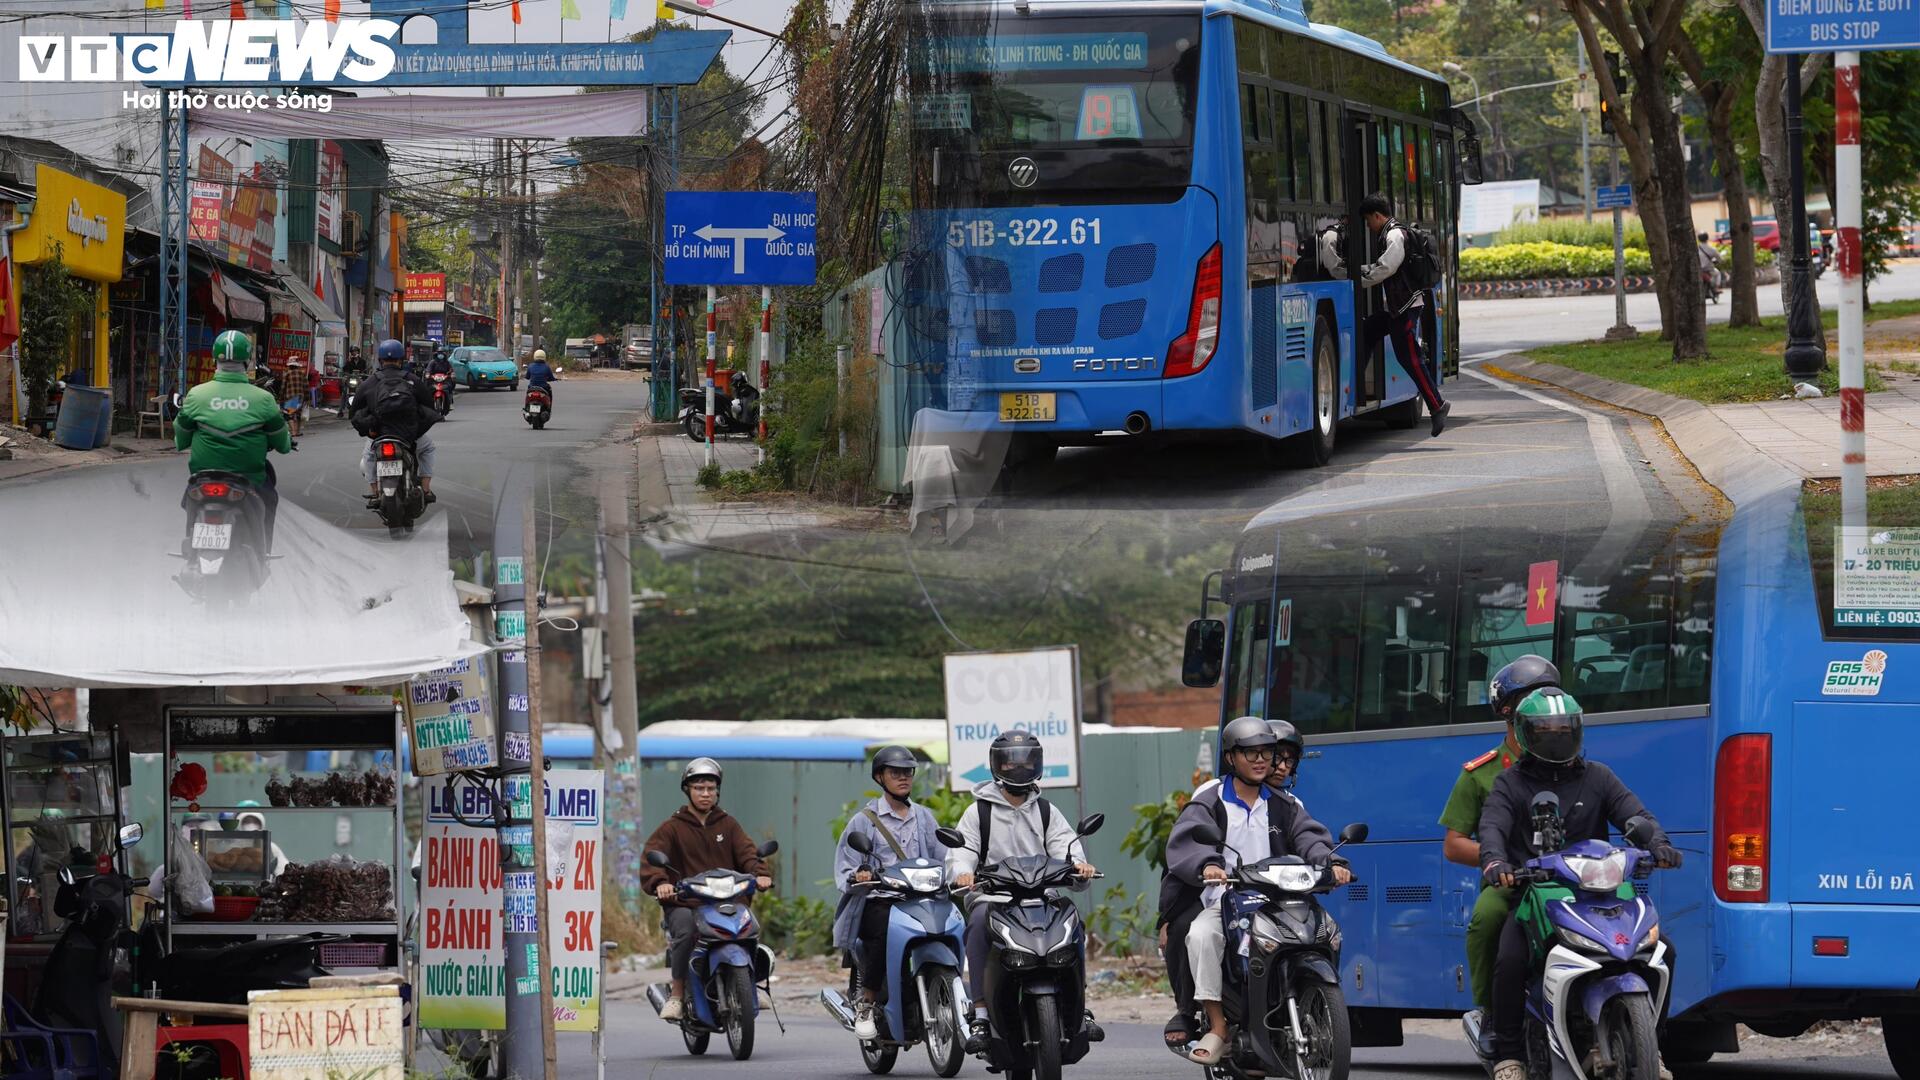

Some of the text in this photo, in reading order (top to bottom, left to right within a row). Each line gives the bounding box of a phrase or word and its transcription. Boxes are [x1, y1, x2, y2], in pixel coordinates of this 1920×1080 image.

[1811, 21, 1880, 41] BUS STOP
[1001, 46, 1024, 63] LINH
[1027, 44, 1063, 62] TRUNG
[1072, 44, 1088, 61] ĐH
[1092, 38, 1121, 63] QUỐC
[1124, 43, 1142, 60] GIA
[406, 50, 425, 72] KẾT
[427, 53, 443, 72] XÂY
[447, 53, 471, 77] DỰNG
[474, 55, 489, 72] GIA
[492, 51, 513, 72] ĐÌNH
[516, 51, 535, 72] VĂN
[583, 48, 602, 71] PHỐ
[604, 50, 623, 71] VĂN
[625, 49, 645, 71] HÓA
[191, 207, 219, 220] XE GA
[772, 213, 816, 229] ĐẠI HỌC
[672, 224, 686, 239] TP
[950, 217, 1101, 248] 51B-322.61
[665, 241, 730, 258] HỒ CHÍ MINH
[765, 238, 815, 256] QUỐC GIA
[1052, 347, 1061, 355] RA
[210, 396, 249, 411] Grab
[1015, 394, 1039, 406] 51B
[1006, 408, 1049, 421] 322.61
[1857, 546, 1871, 556] LÁI
[1874, 548, 1885, 556] XE
[1888, 546, 1910, 556] BUÝT
[1844, 559, 1856, 570] 17
[1866, 560, 1882, 570] 20
[1837, 610, 1863, 623] LIÊN
[1866, 610, 1885, 626] HỆ:
[1829, 663, 1862, 673] GAS
[953, 658, 1063, 705] CƠM
[1826, 675, 1880, 686] SOUTH
[955, 721, 1000, 741] TRƯA
[558, 788, 597, 817] MAI
[428, 826, 473, 888] BÁNH
[573, 840, 596, 891] 2K
[1818, 869, 1914, 890] XIN LỖI ĐÃ
[426, 899, 491, 950] BÁNH
[564, 910, 594, 951] 3K
[513, 914, 525, 932] 115
[426, 957, 462, 997] NƯỚC
[466, 954, 493, 997] GIẢI
[564, 966, 593, 1005] LOẠI
[259, 1006, 314, 1050] BÁN
[325, 1003, 358, 1047] ĐÁ
